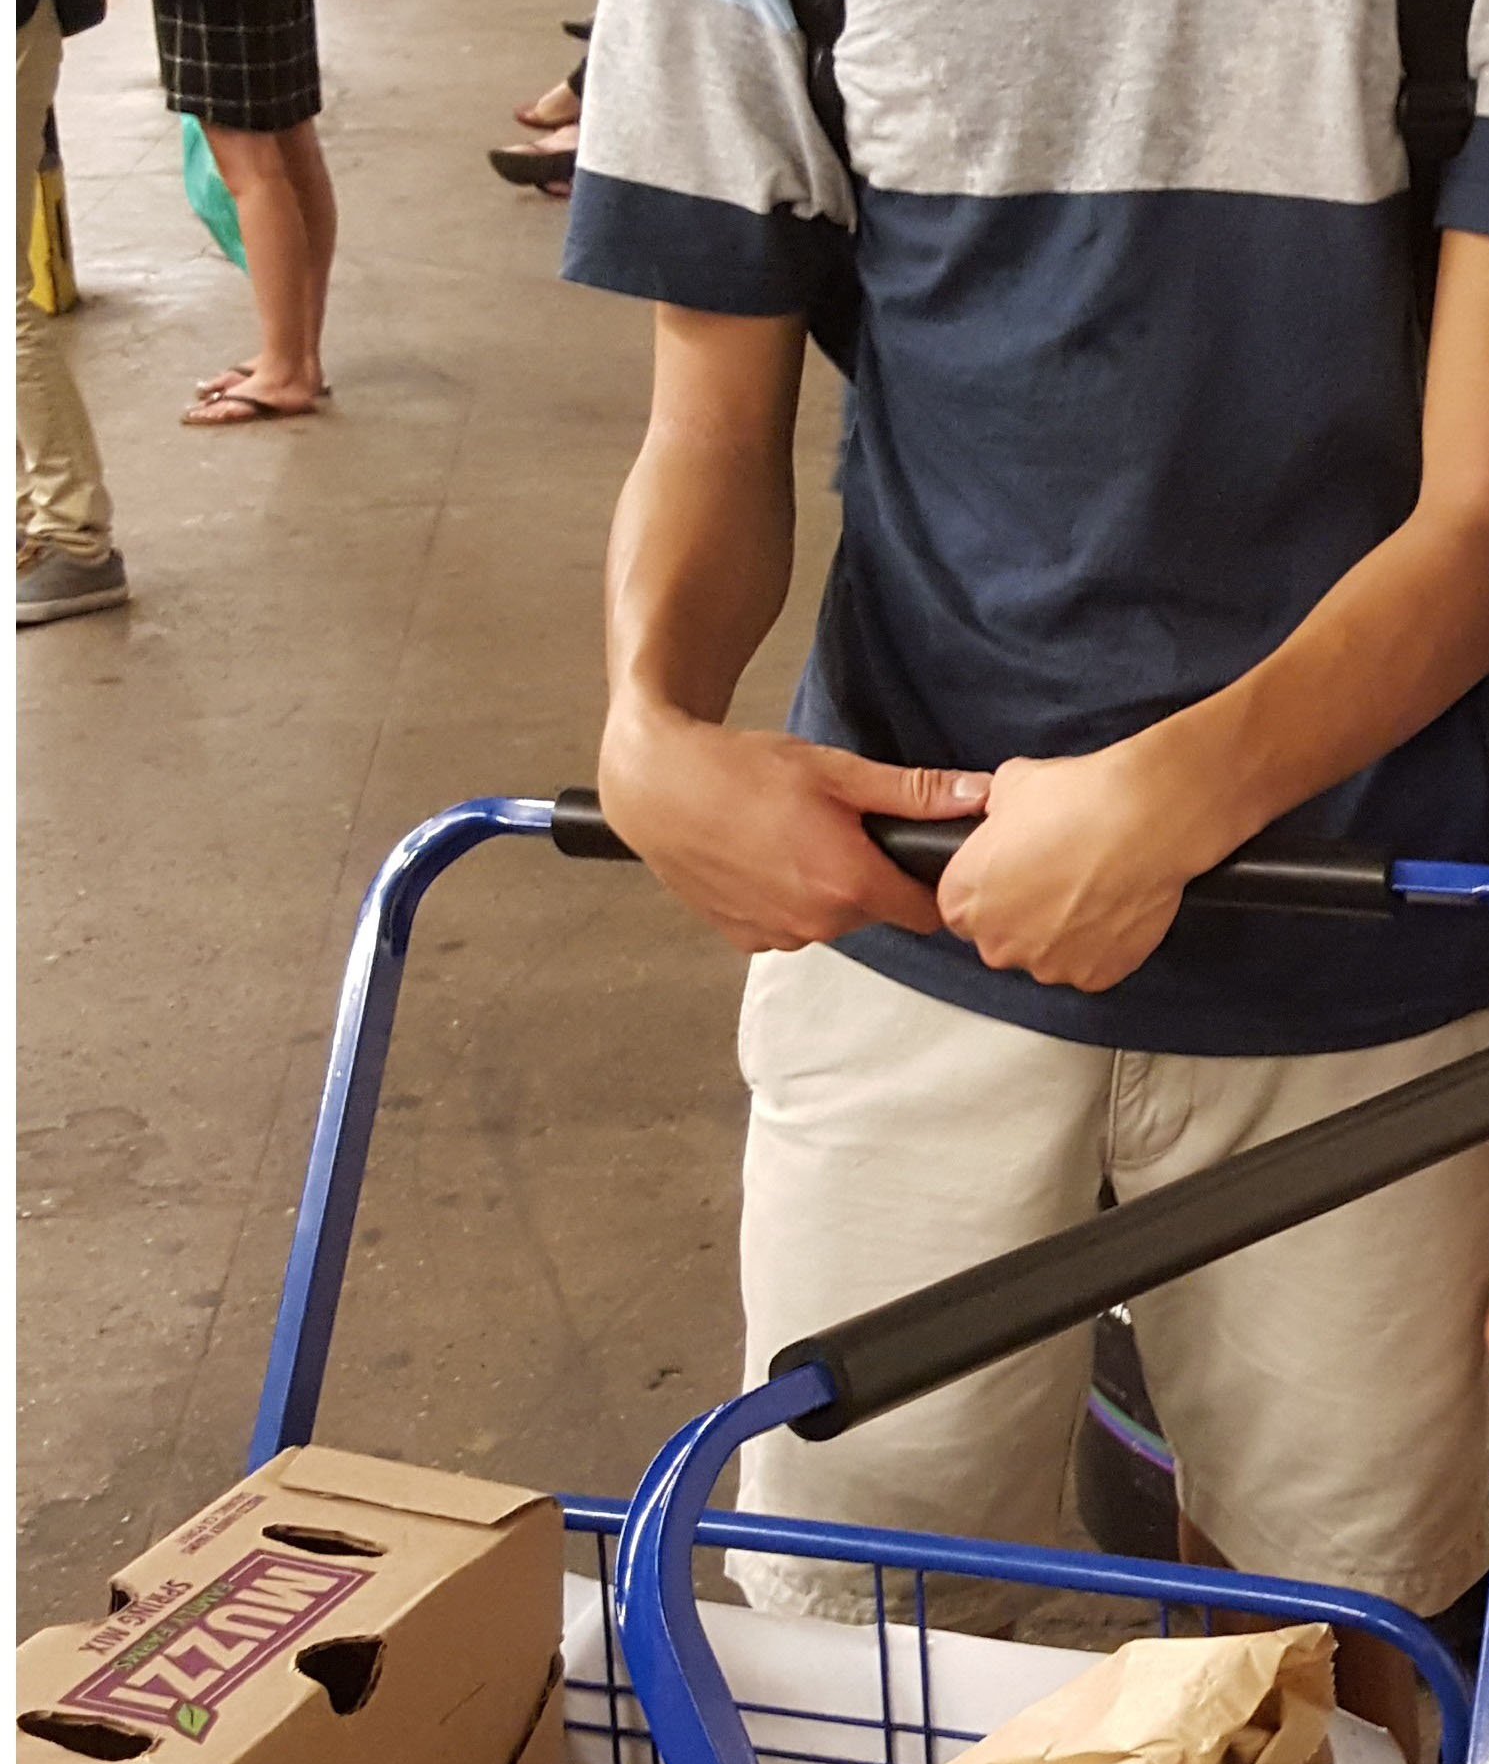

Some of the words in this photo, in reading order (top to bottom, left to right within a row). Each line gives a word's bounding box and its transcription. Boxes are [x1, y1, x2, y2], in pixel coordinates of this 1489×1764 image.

[123, 1578, 195, 1628] SPRING
[77, 1625, 132, 1656] MIX
[108, 1565, 341, 1710] MUZZI
[111, 1624, 176, 1672] FARMS
